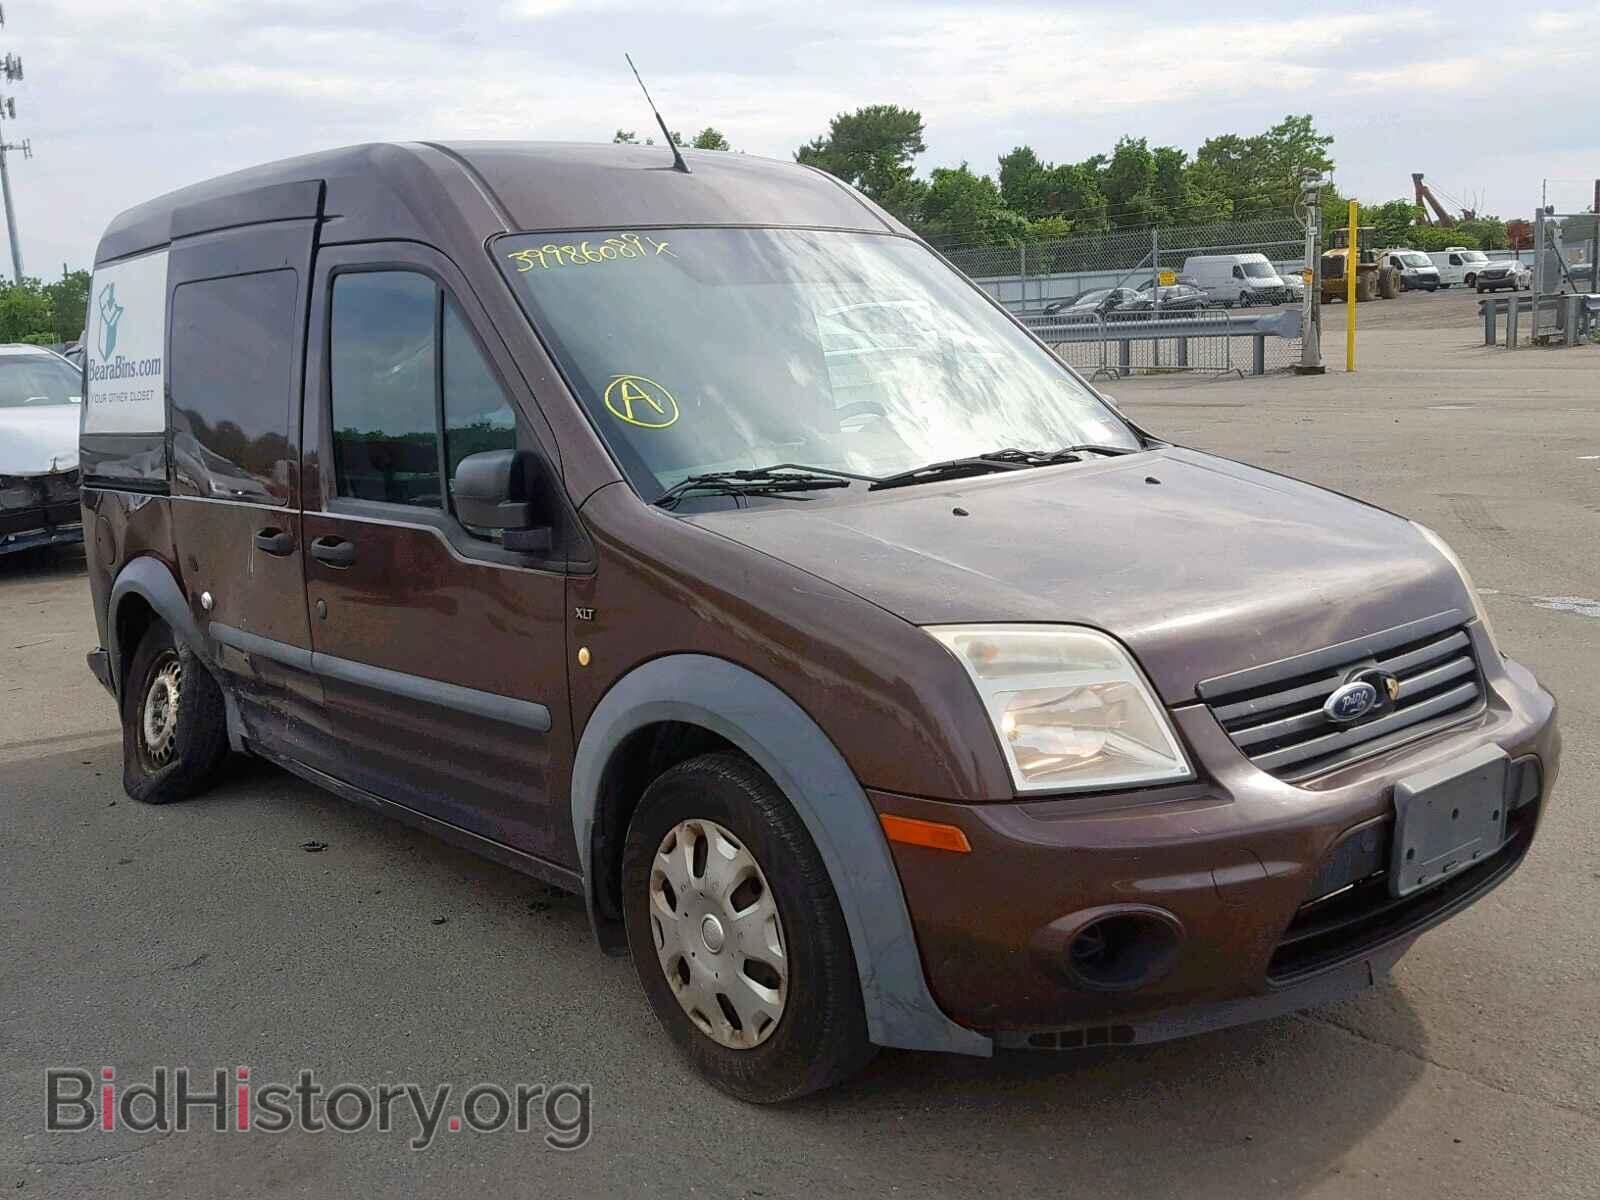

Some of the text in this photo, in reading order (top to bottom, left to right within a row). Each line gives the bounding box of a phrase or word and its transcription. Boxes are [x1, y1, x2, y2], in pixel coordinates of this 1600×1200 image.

[89, 355, 161, 381] BearaBins.com
[130, 389, 154, 402] CLOSET
[621, 379, 665, 419] A
[575, 607, 594, 621] XLT
